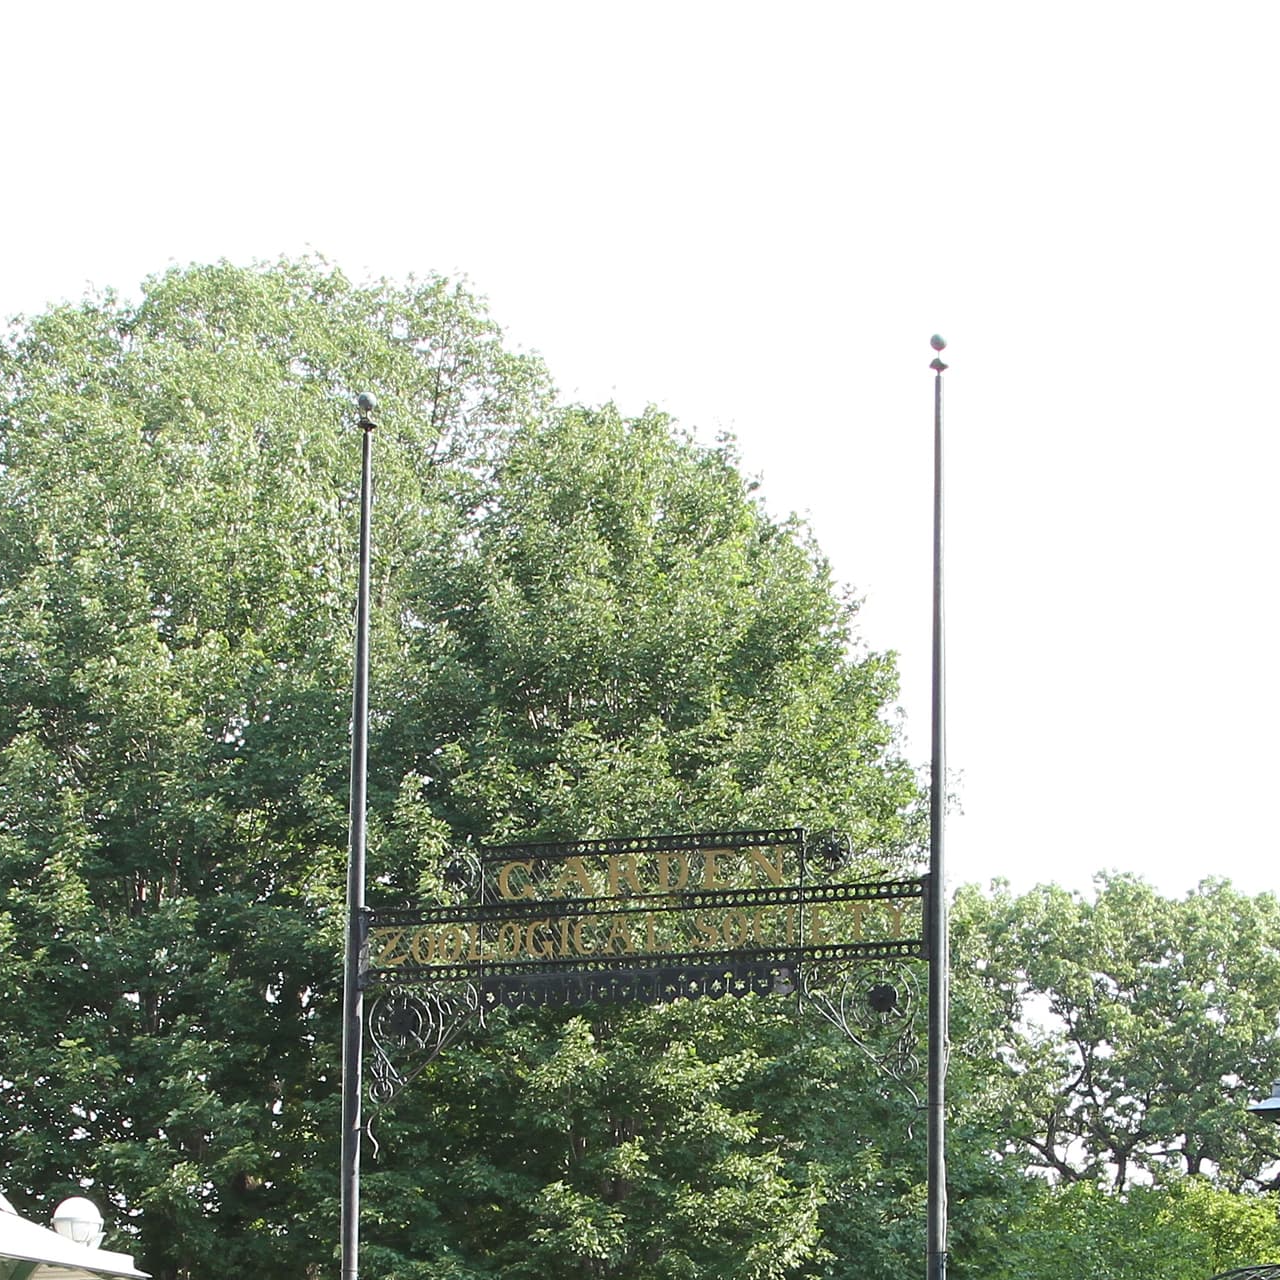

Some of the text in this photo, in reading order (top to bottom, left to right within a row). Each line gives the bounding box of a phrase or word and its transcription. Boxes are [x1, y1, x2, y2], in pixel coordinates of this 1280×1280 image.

[497, 845, 788, 901] GARDEN
[368, 901, 910, 967] ZOOLOGICAL SOCIETY
